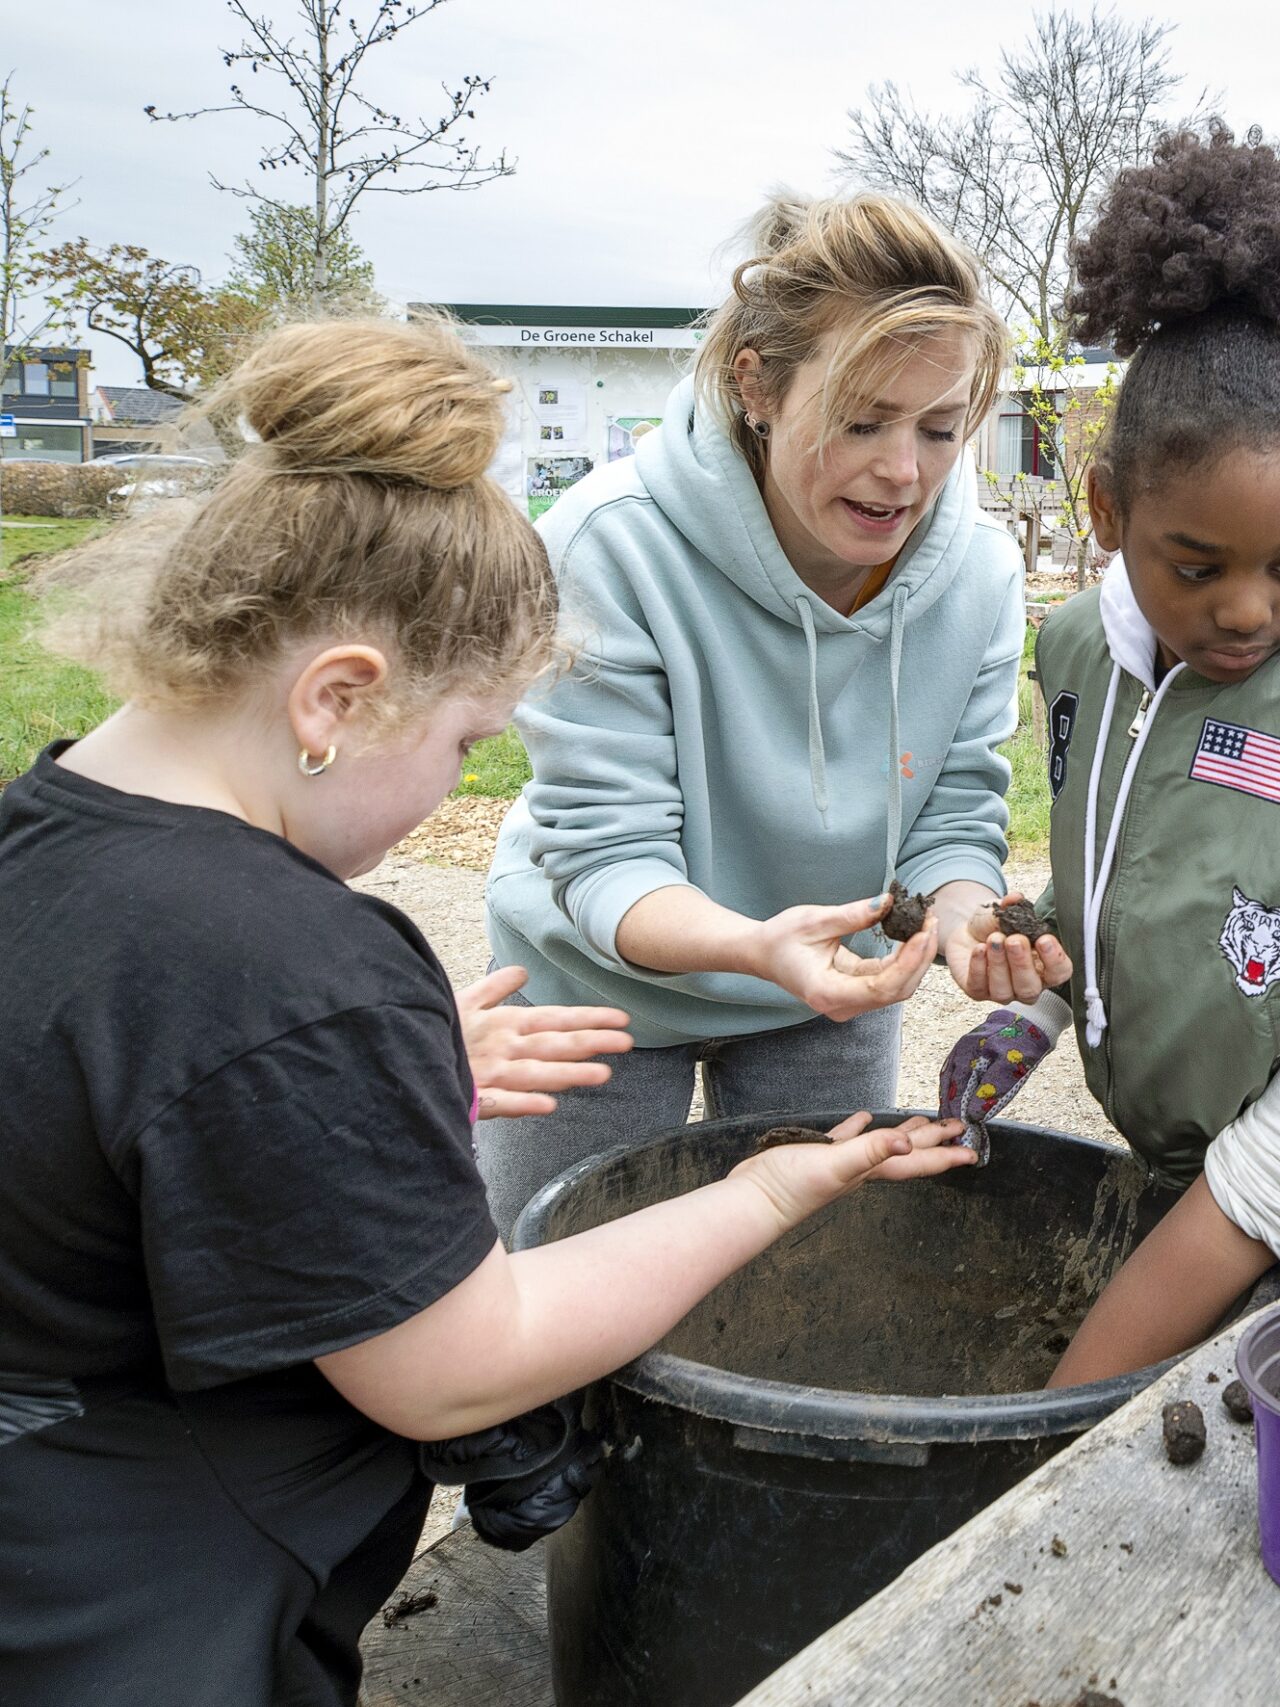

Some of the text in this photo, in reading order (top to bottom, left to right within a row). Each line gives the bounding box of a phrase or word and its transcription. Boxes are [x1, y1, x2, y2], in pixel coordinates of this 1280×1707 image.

[521, 330, 653, 343] De Groene Schakel
